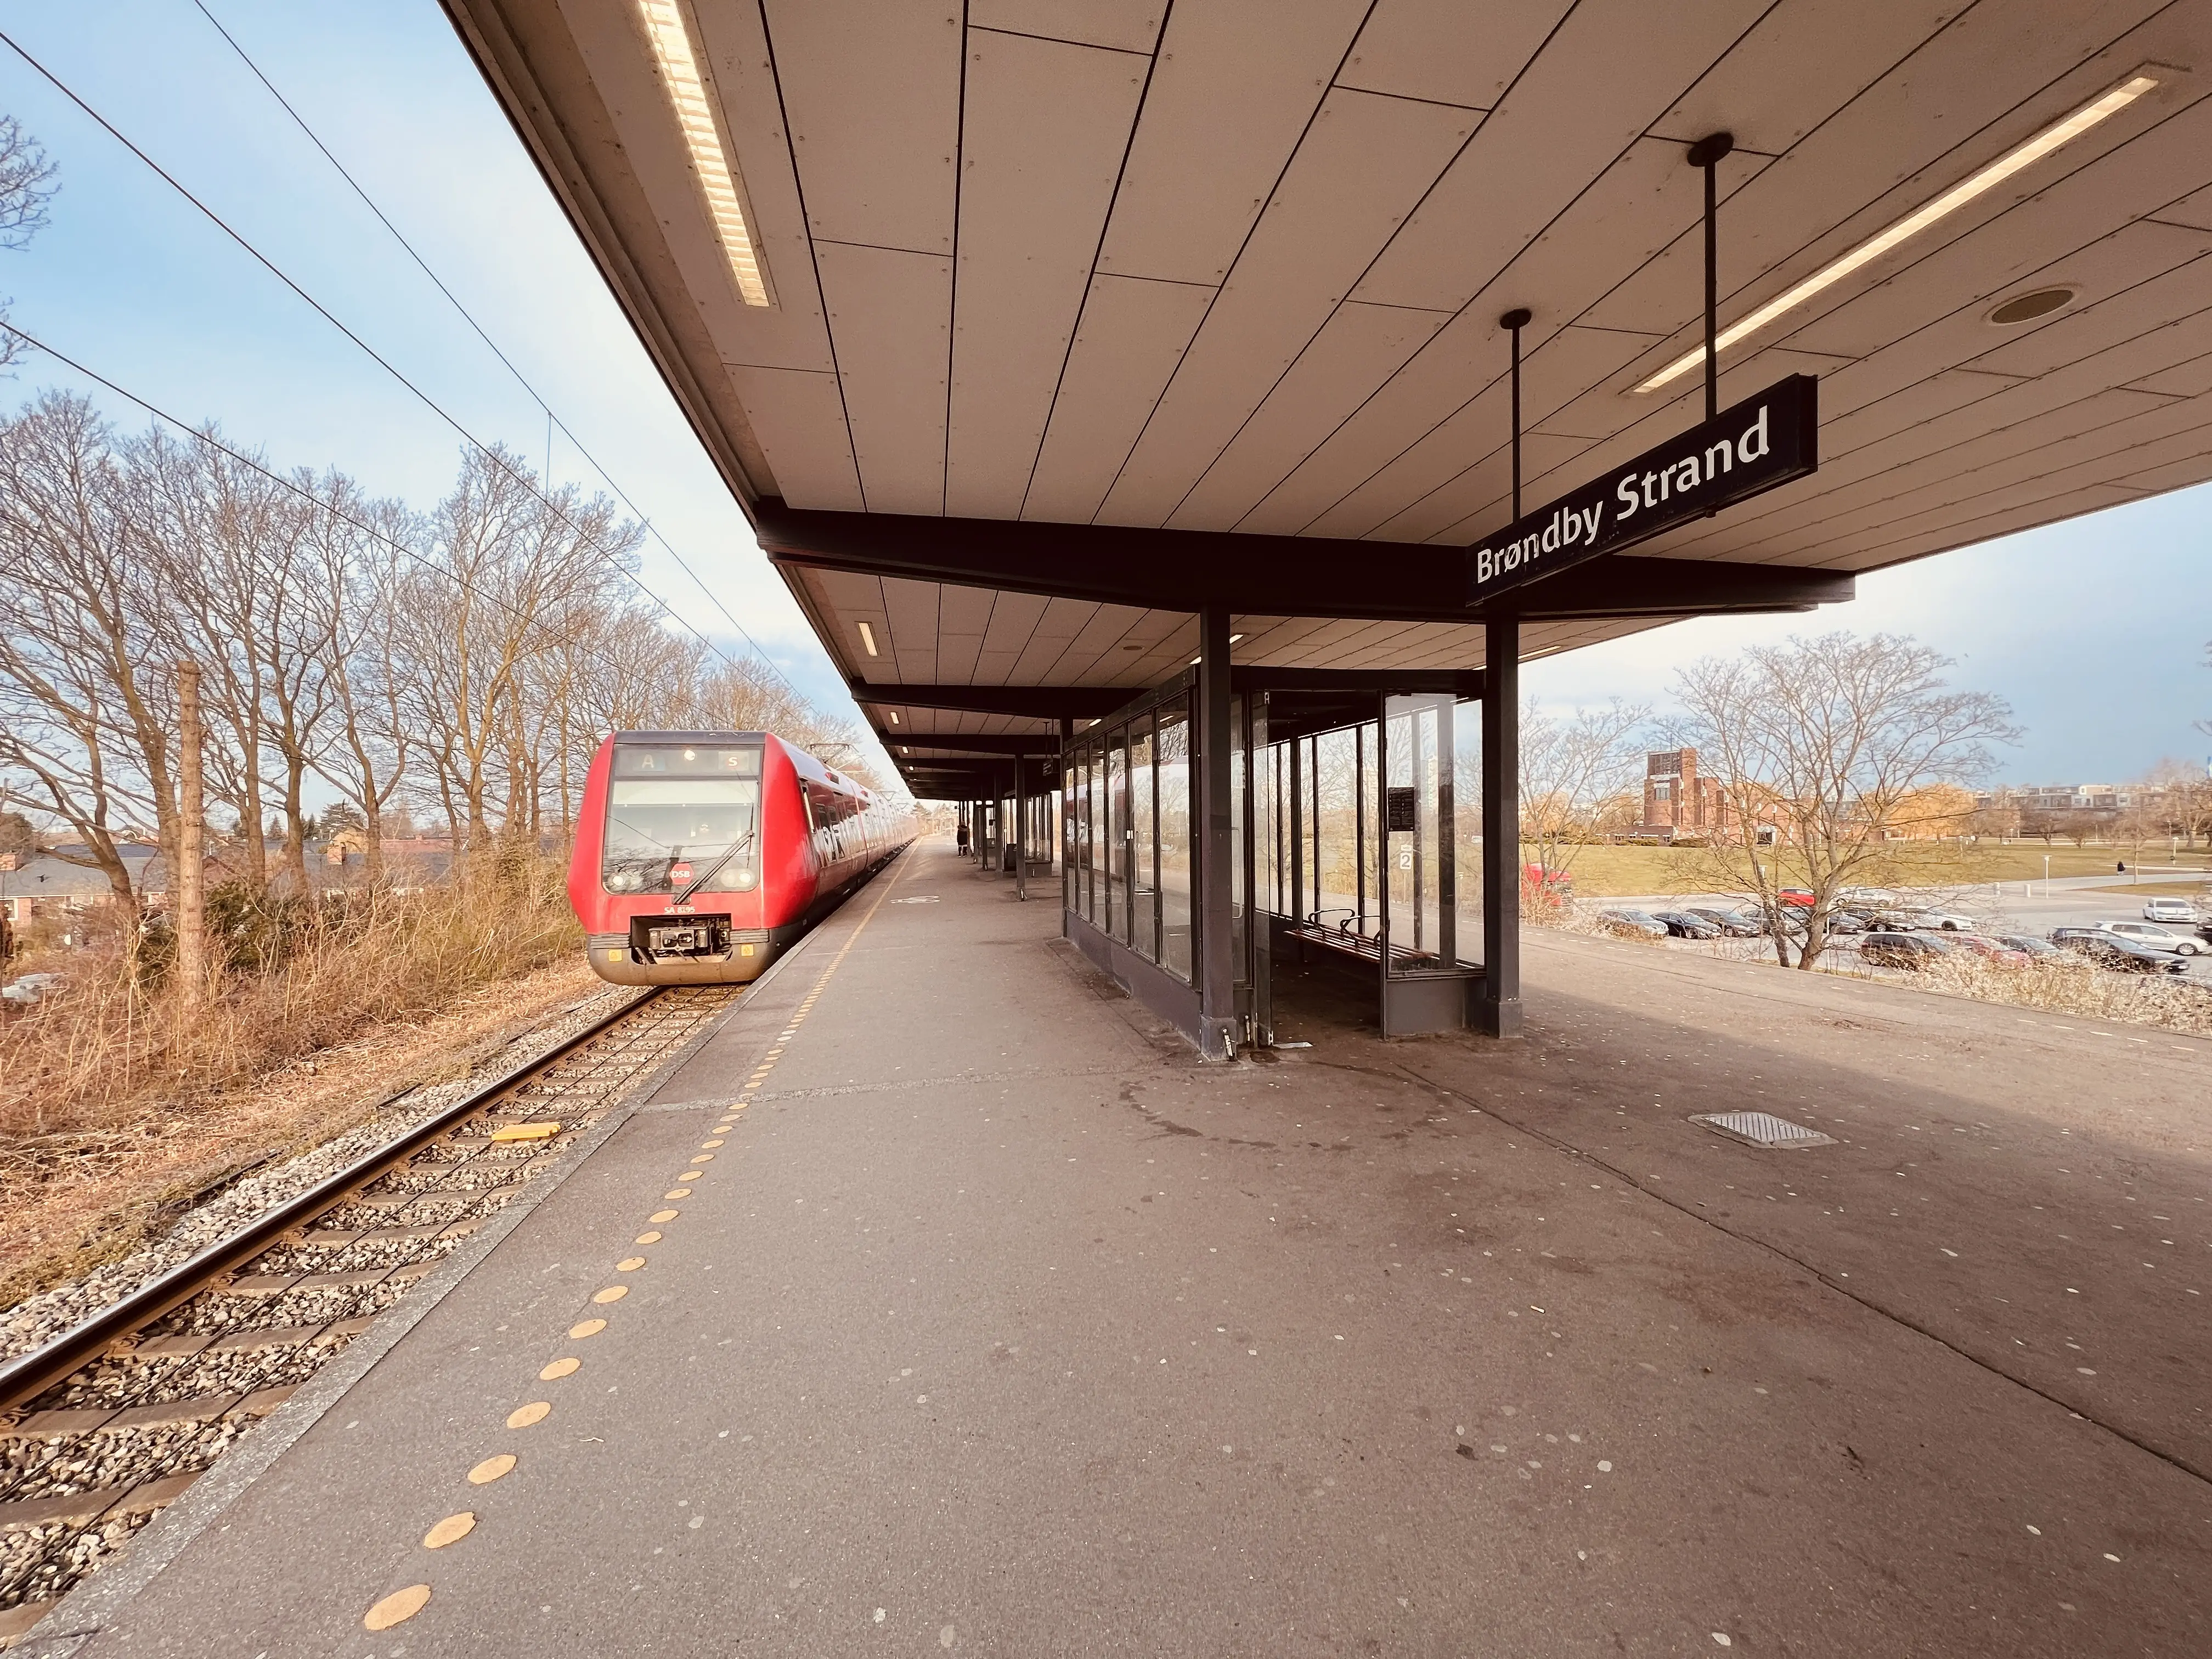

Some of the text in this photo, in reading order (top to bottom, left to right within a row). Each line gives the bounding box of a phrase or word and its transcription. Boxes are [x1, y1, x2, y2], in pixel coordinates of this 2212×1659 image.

[1477, 405, 1770, 583] Brøndby Strand
[641, 754, 654, 769] A
[729, 757, 738, 766] S
[1402, 854, 1410, 867] 2
